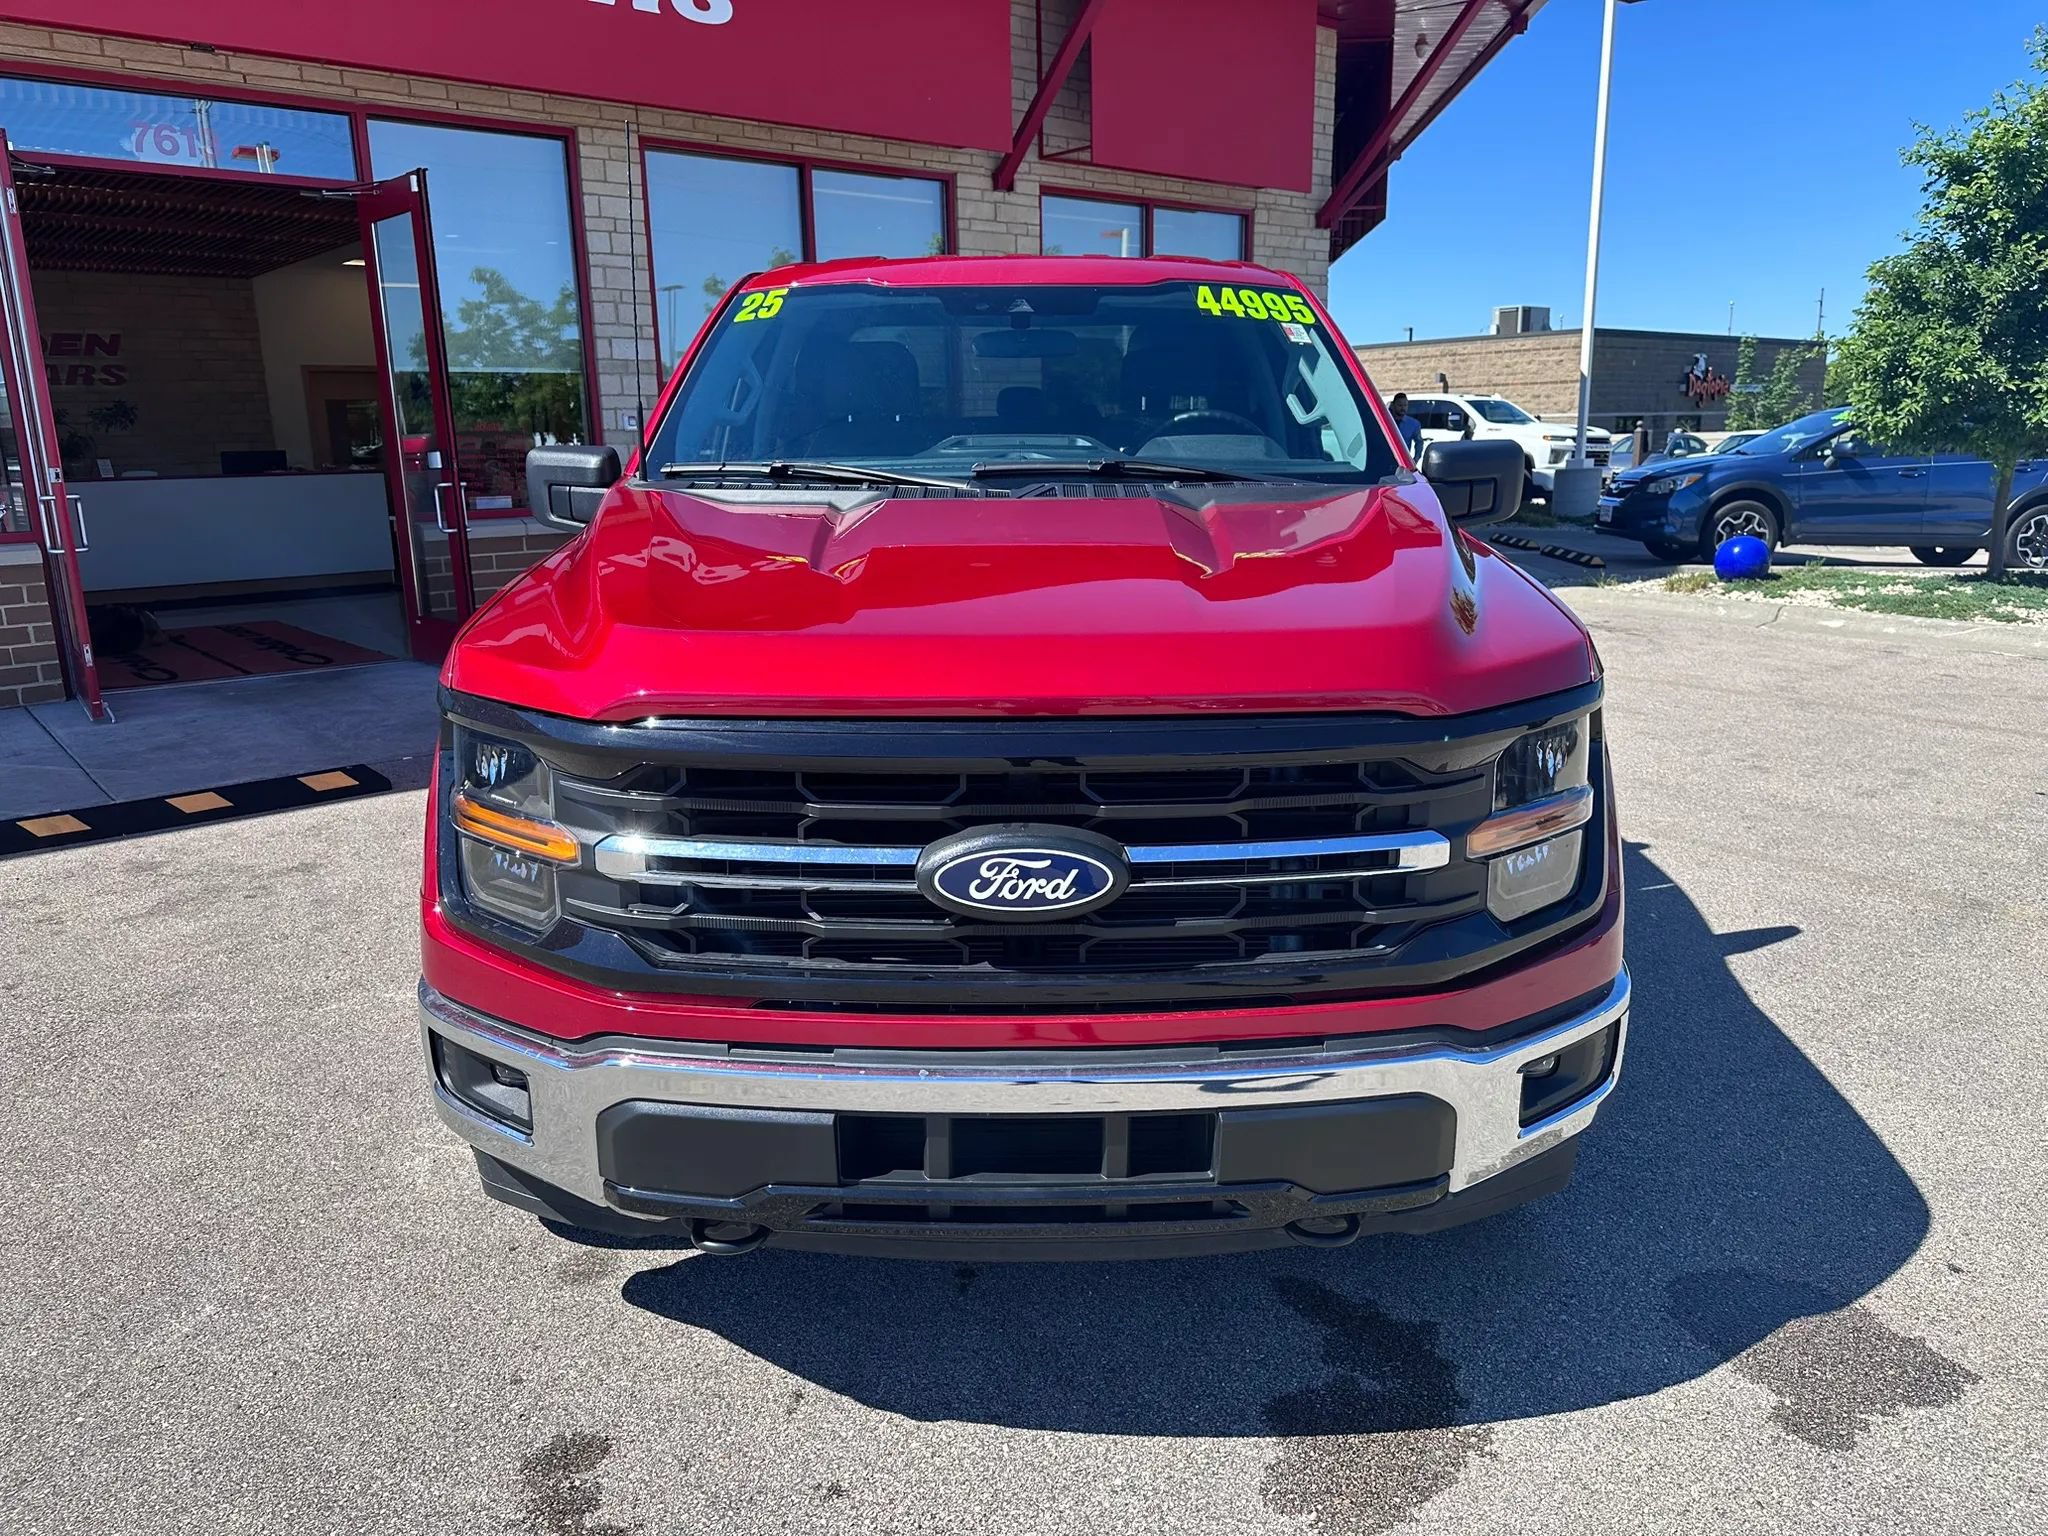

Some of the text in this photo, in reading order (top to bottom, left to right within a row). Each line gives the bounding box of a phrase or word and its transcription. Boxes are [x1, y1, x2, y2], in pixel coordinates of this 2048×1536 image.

[733, 288, 789, 323] 25
[1197, 285, 1316, 325] 44995
[968, 857, 1080, 900] Ford
